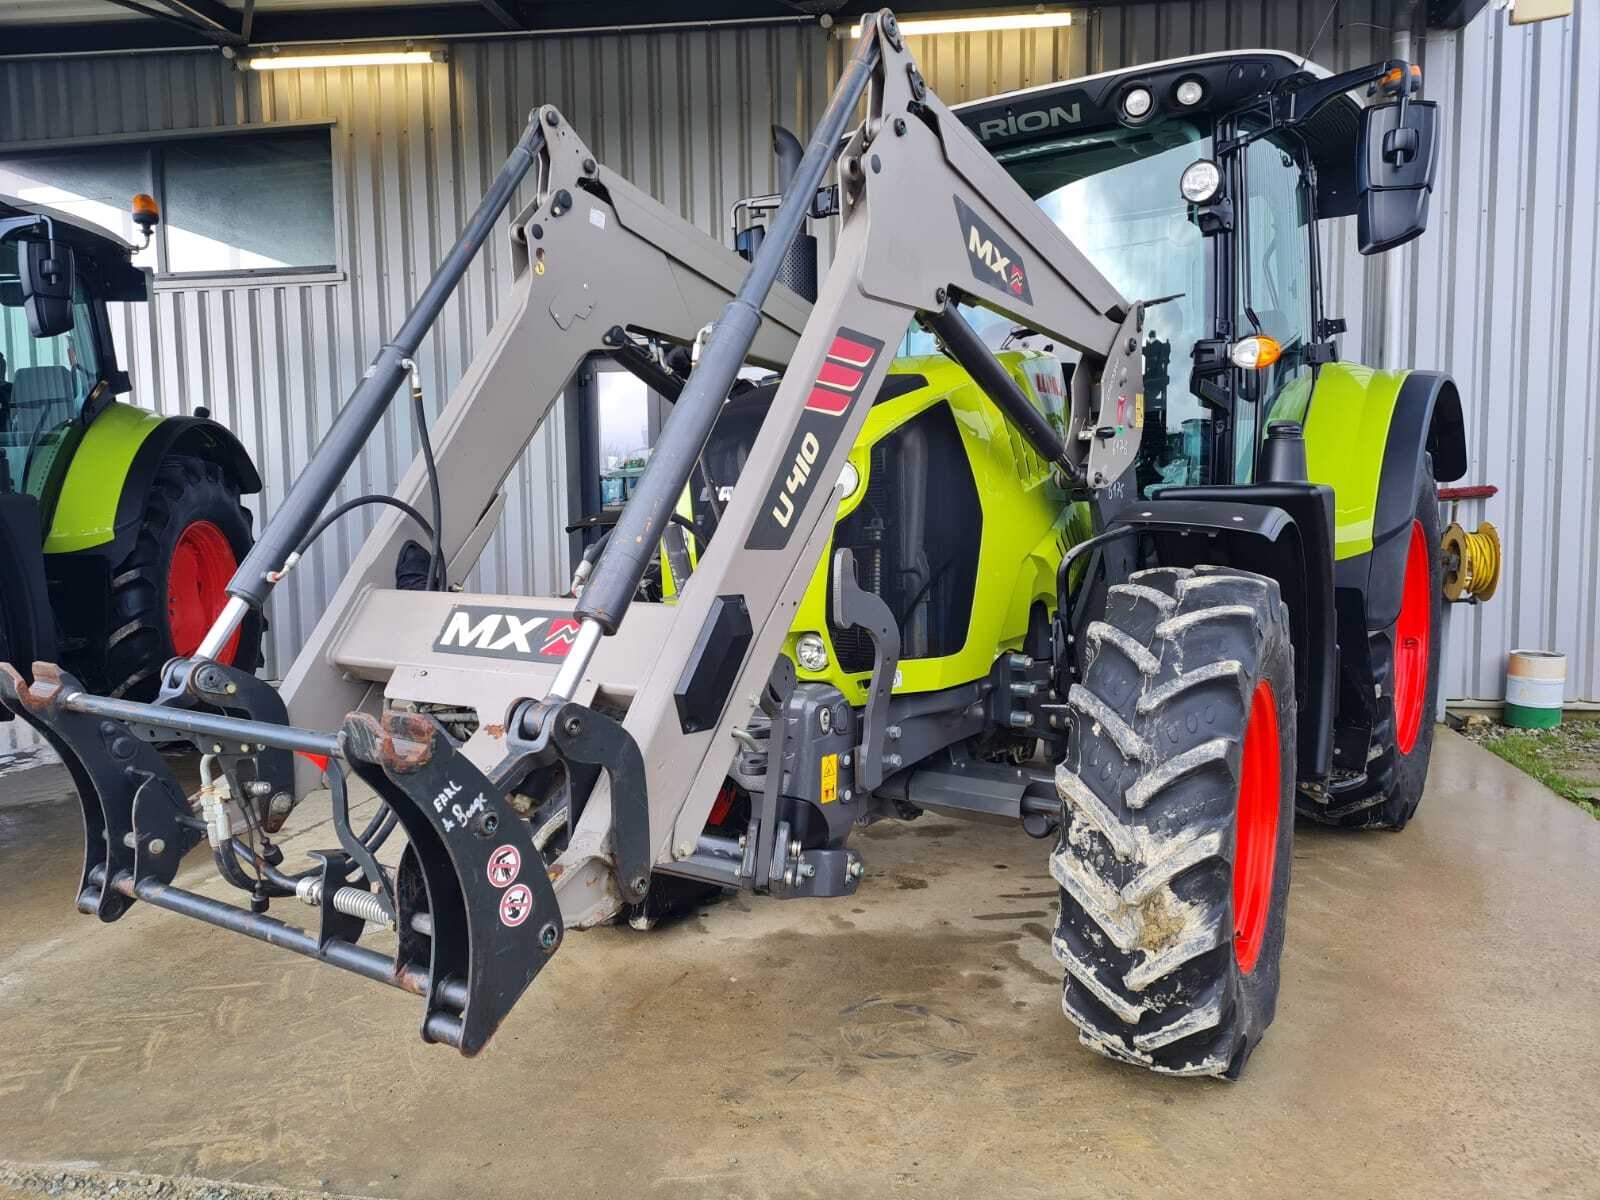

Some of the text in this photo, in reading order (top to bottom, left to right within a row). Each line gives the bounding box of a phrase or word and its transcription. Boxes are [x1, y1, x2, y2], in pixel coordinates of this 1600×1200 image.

[969, 225, 1010, 283] MX
[772, 431, 820, 528] U 410
[439, 611, 549, 653] MX
[433, 780, 463, 813] EARL
